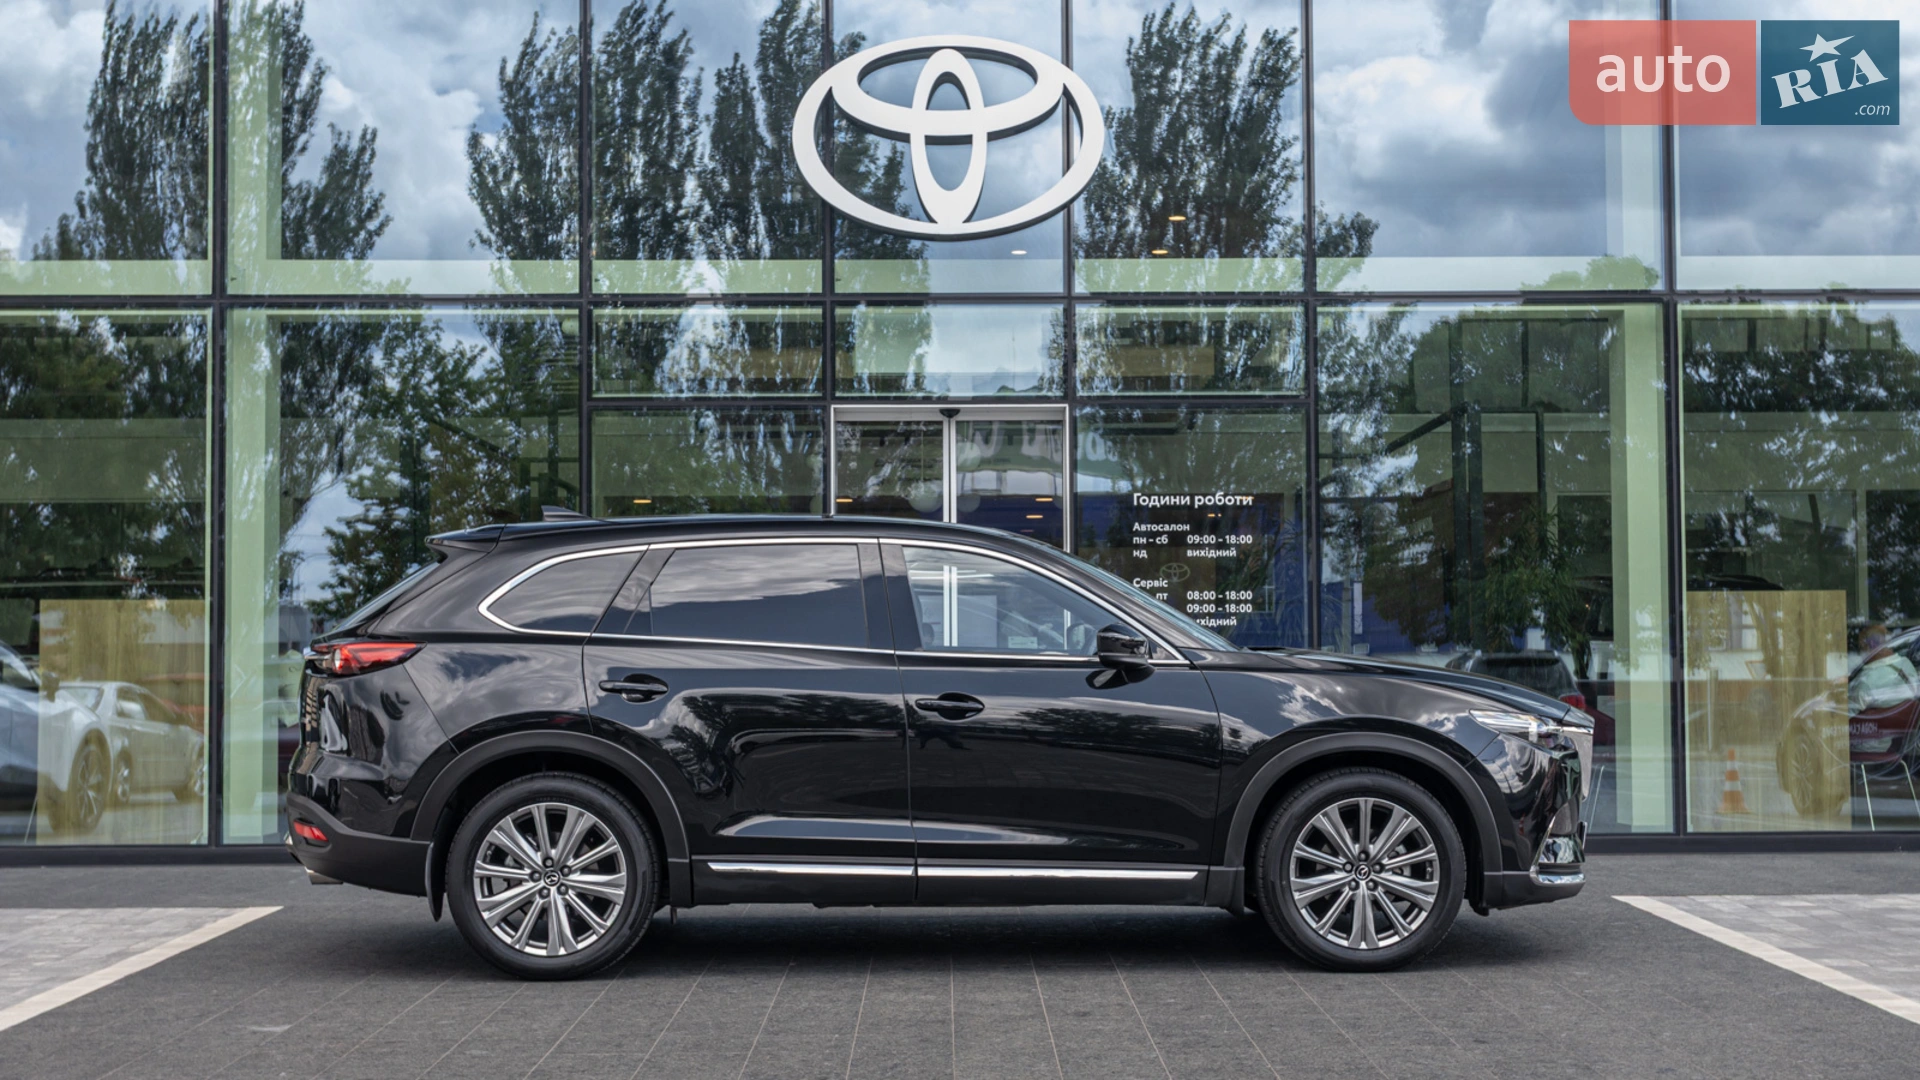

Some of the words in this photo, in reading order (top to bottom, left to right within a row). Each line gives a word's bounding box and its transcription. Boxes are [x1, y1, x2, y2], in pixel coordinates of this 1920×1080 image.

[1132, 493, 1190, 508] Години
[1194, 490, 1253, 508] роботи
[1132, 522, 1190, 532] Автосалон
[1132, 536, 1147, 544] пн
[1155, 534, 1169, 545] сб
[1187, 534, 1216, 545] 09:00
[1224, 534, 1253, 545] 18:00
[1132, 549, 1147, 559] нд
[1186, 546, 1237, 559] вихідний
[1132, 577, 1169, 590] Сервіс
[1156, 592, 1169, 601] пт
[1187, 590, 1216, 601] 08:00
[1224, 590, 1253, 601] 18:00
[1187, 603, 1216, 614] 09:00
[1224, 603, 1253, 614] 18:00
[1195, 616, 1237, 627] хідний
